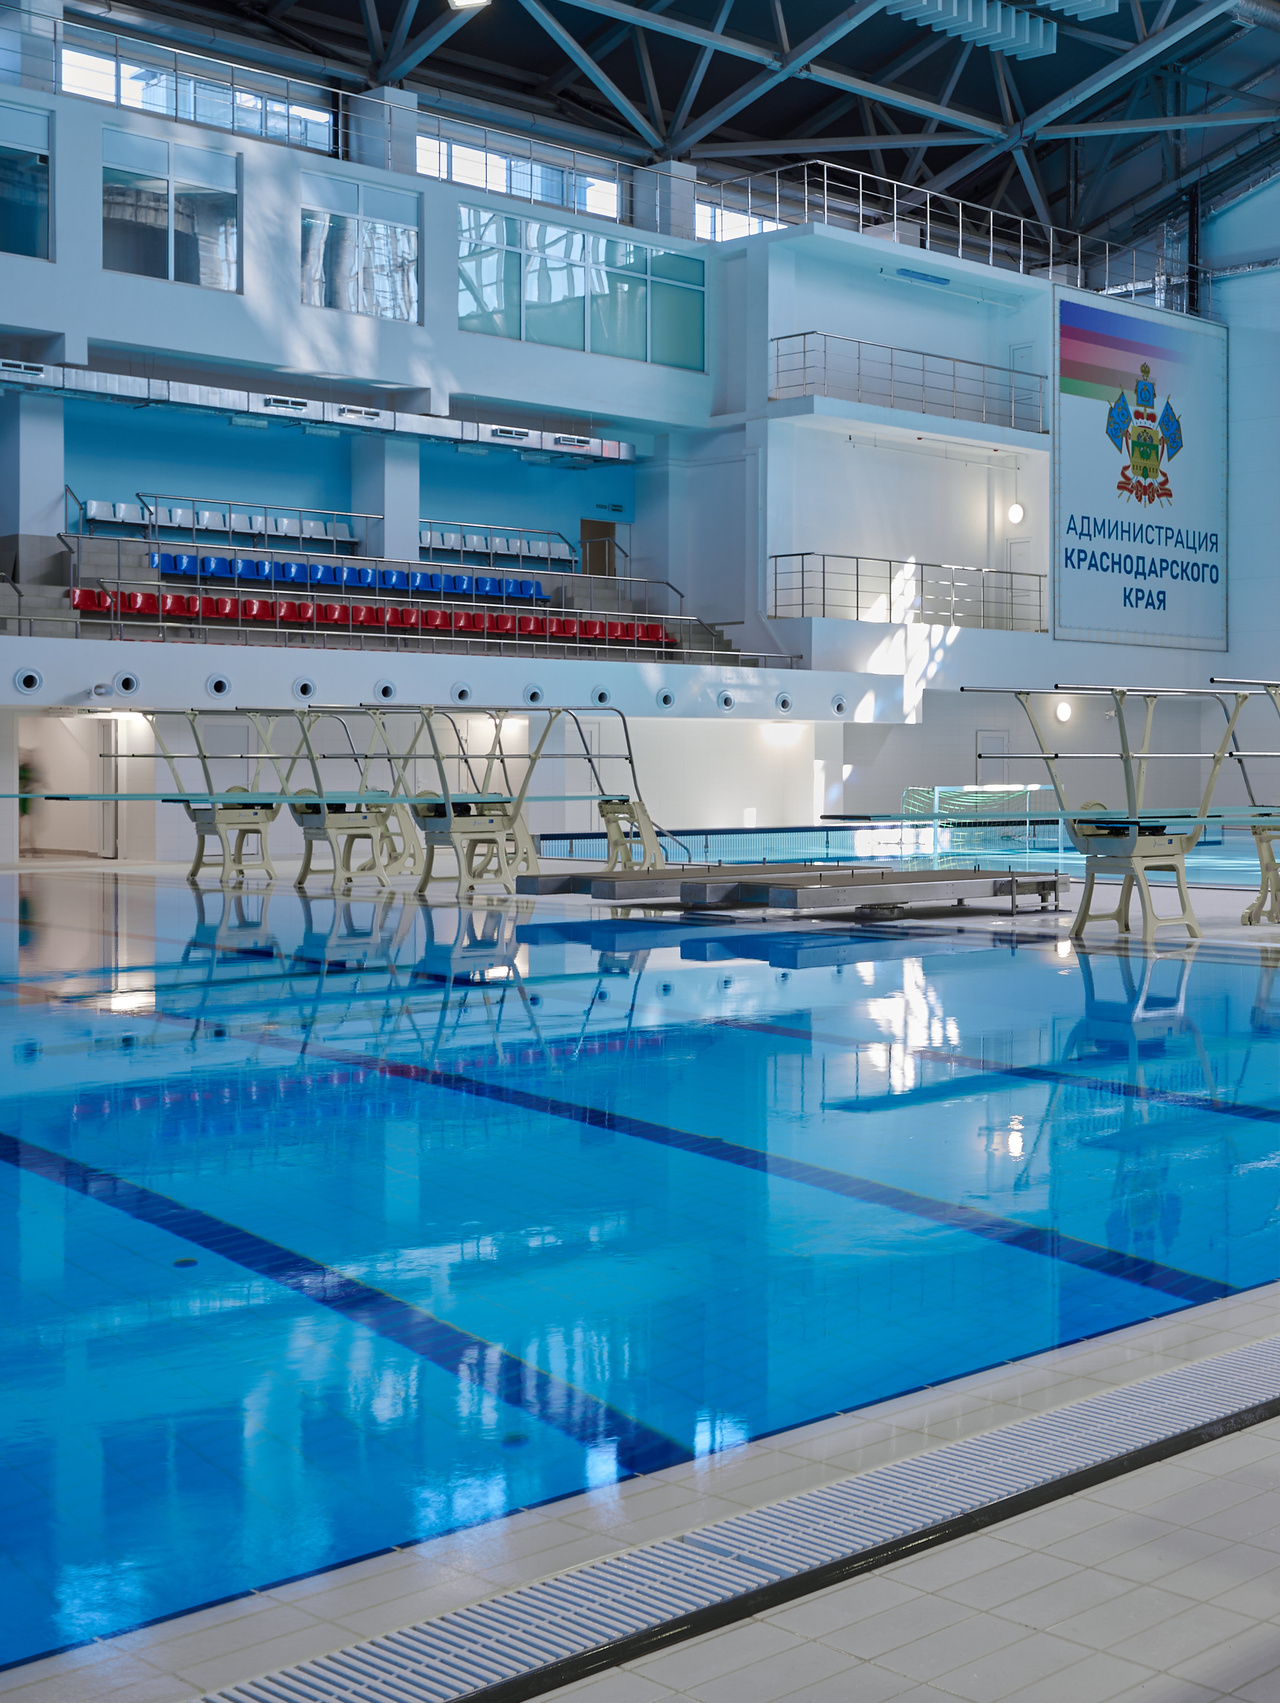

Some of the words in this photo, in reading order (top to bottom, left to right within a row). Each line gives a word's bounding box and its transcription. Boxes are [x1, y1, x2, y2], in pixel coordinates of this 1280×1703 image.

[1066, 513, 1219, 554] АДМИНИСТРАЦИЯ
[1064, 547, 1219, 584] КРАСНОДАРСКОГО
[1123, 587, 1167, 611] КРАЯ
